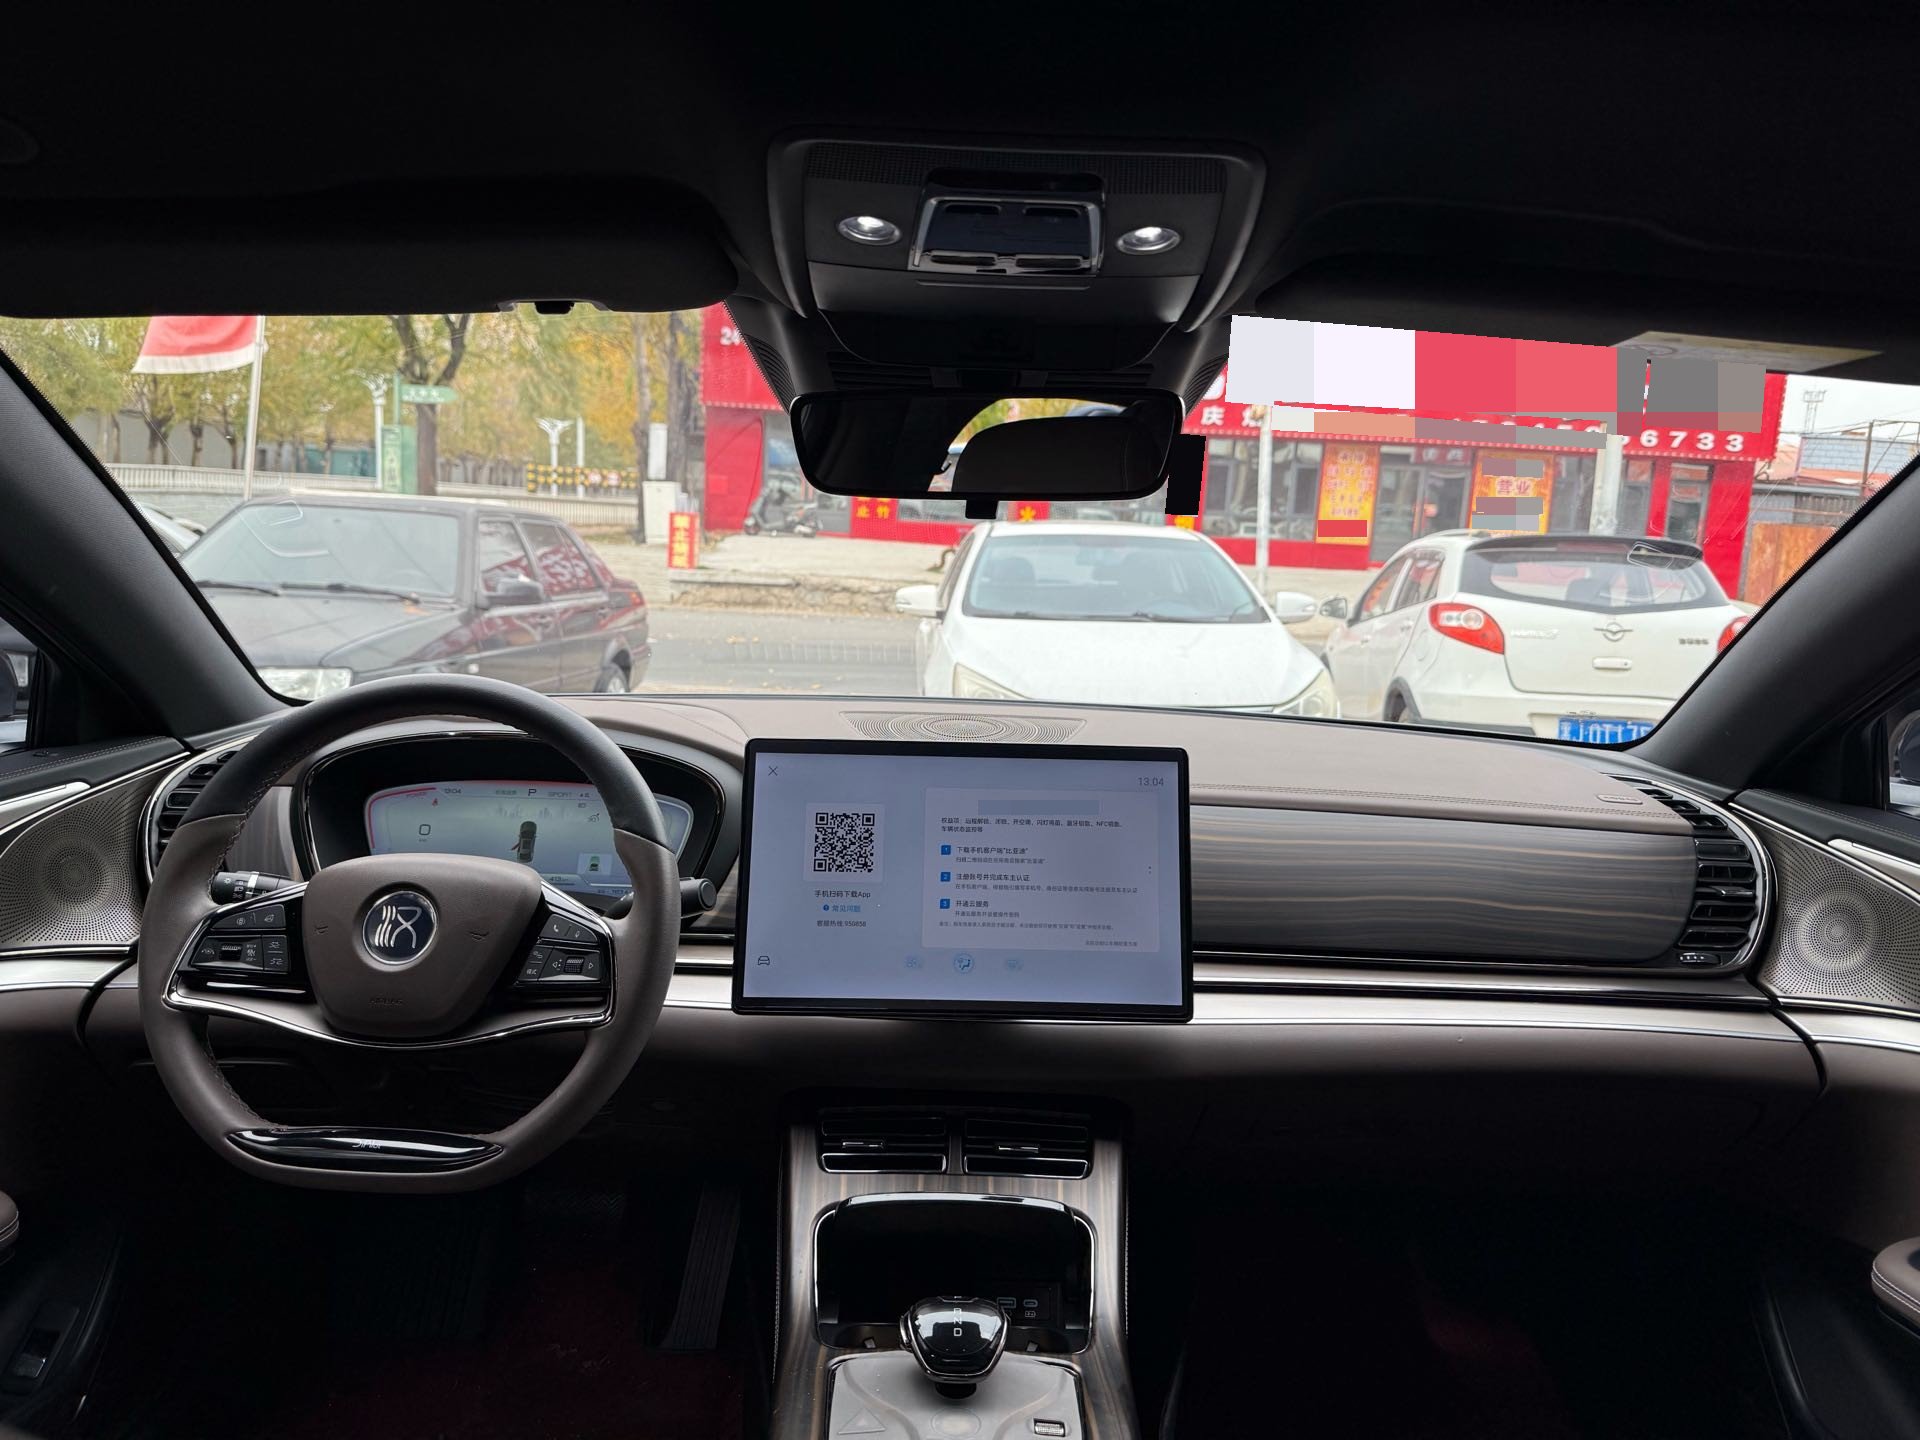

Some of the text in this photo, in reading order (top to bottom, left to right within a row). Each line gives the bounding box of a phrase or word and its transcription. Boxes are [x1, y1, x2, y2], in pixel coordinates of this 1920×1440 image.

[528, 788, 537, 797] P
[814, 889, 871, 899] 手机扫码下载App
[953, 1327, 962, 1337] D
